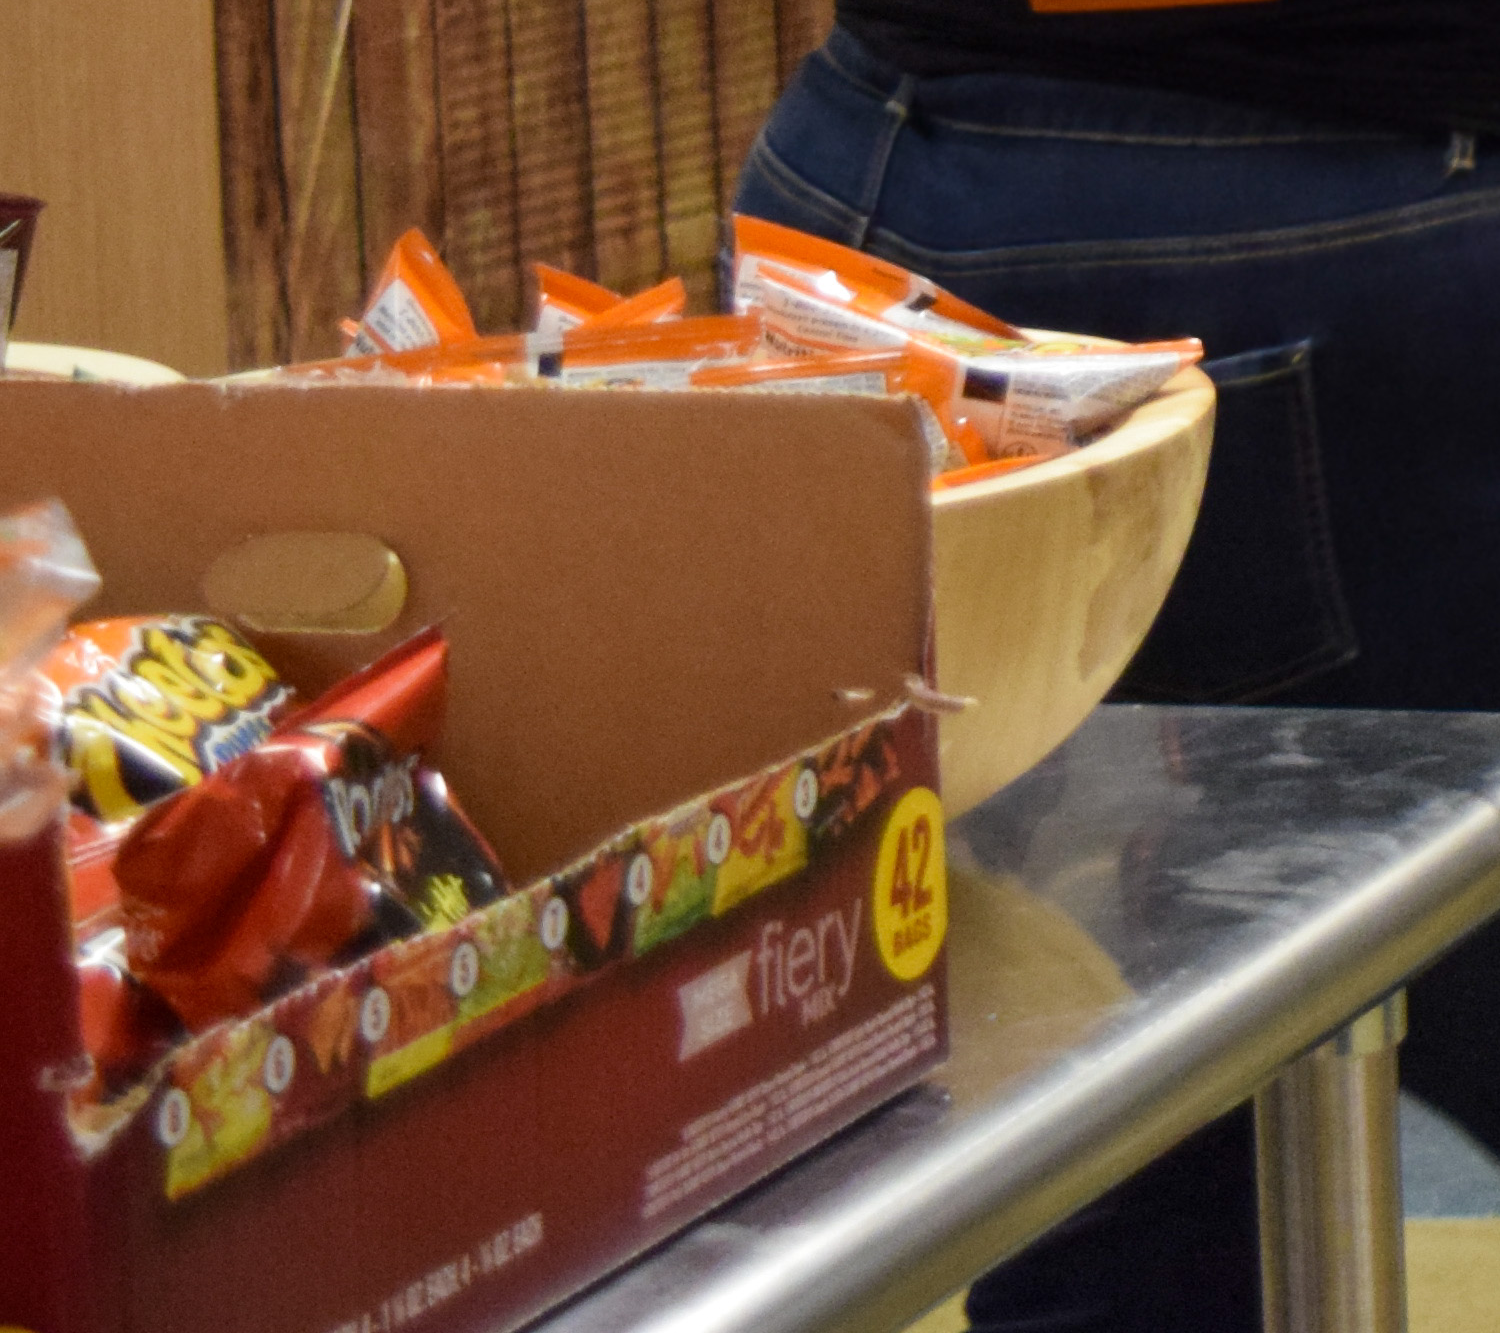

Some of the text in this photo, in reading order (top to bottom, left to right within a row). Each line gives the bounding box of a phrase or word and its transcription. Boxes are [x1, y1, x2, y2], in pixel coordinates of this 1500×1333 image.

[890, 813, 934, 920] 42
[757, 897, 863, 1016] fiery
[892, 917, 933, 959] BAGS
